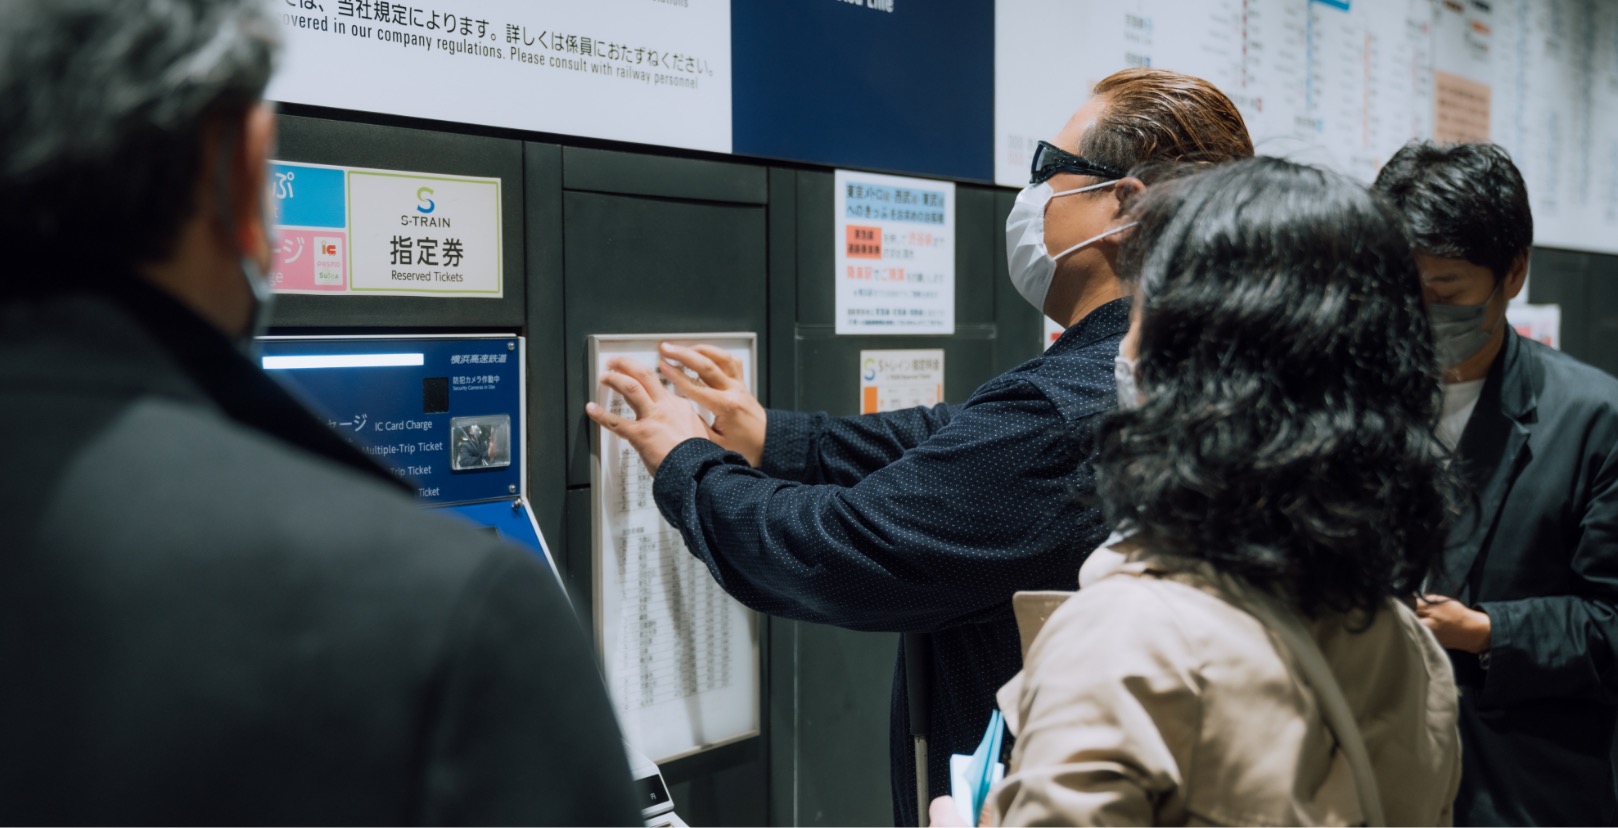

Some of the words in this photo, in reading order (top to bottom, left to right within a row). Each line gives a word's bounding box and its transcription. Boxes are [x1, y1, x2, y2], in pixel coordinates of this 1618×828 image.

[282, 13, 328, 32] overed
[333, 17, 346, 35] in
[351, 24, 372, 39] our
[377, 28, 432, 51] company
[437, 38, 506, 60] regulations.
[510, 46, 545, 66] Please
[549, 56, 588, 73] consult
[591, 61, 613, 76] with
[616, 66, 651, 85] railway
[654, 73, 699, 89] personnel
[272, 171, 295, 200] ぷ
[400, 214, 451, 228] S-TRAIN
[273, 236, 305, 264] ージ
[389, 235, 464, 268] 指定券
[391, 270, 432, 282] Reserved
[434, 271, 464, 283] Tickets
[450, 353, 508, 365] 横浜高速鉄道
[452, 374, 500, 385] 防犯カメラ作動中
[327, 413, 368, 432] ャージ
[374, 421, 384, 431] IC
[385, 420, 405, 431] Card
[406, 420, 433, 431] Charge
[362, 443, 416, 457] Multiple-Trip
[418, 441, 443, 452] Ticket
[390, 467, 406, 478] Trip
[407, 465, 432, 476] Ticket
[418, 487, 440, 497] Ticket
